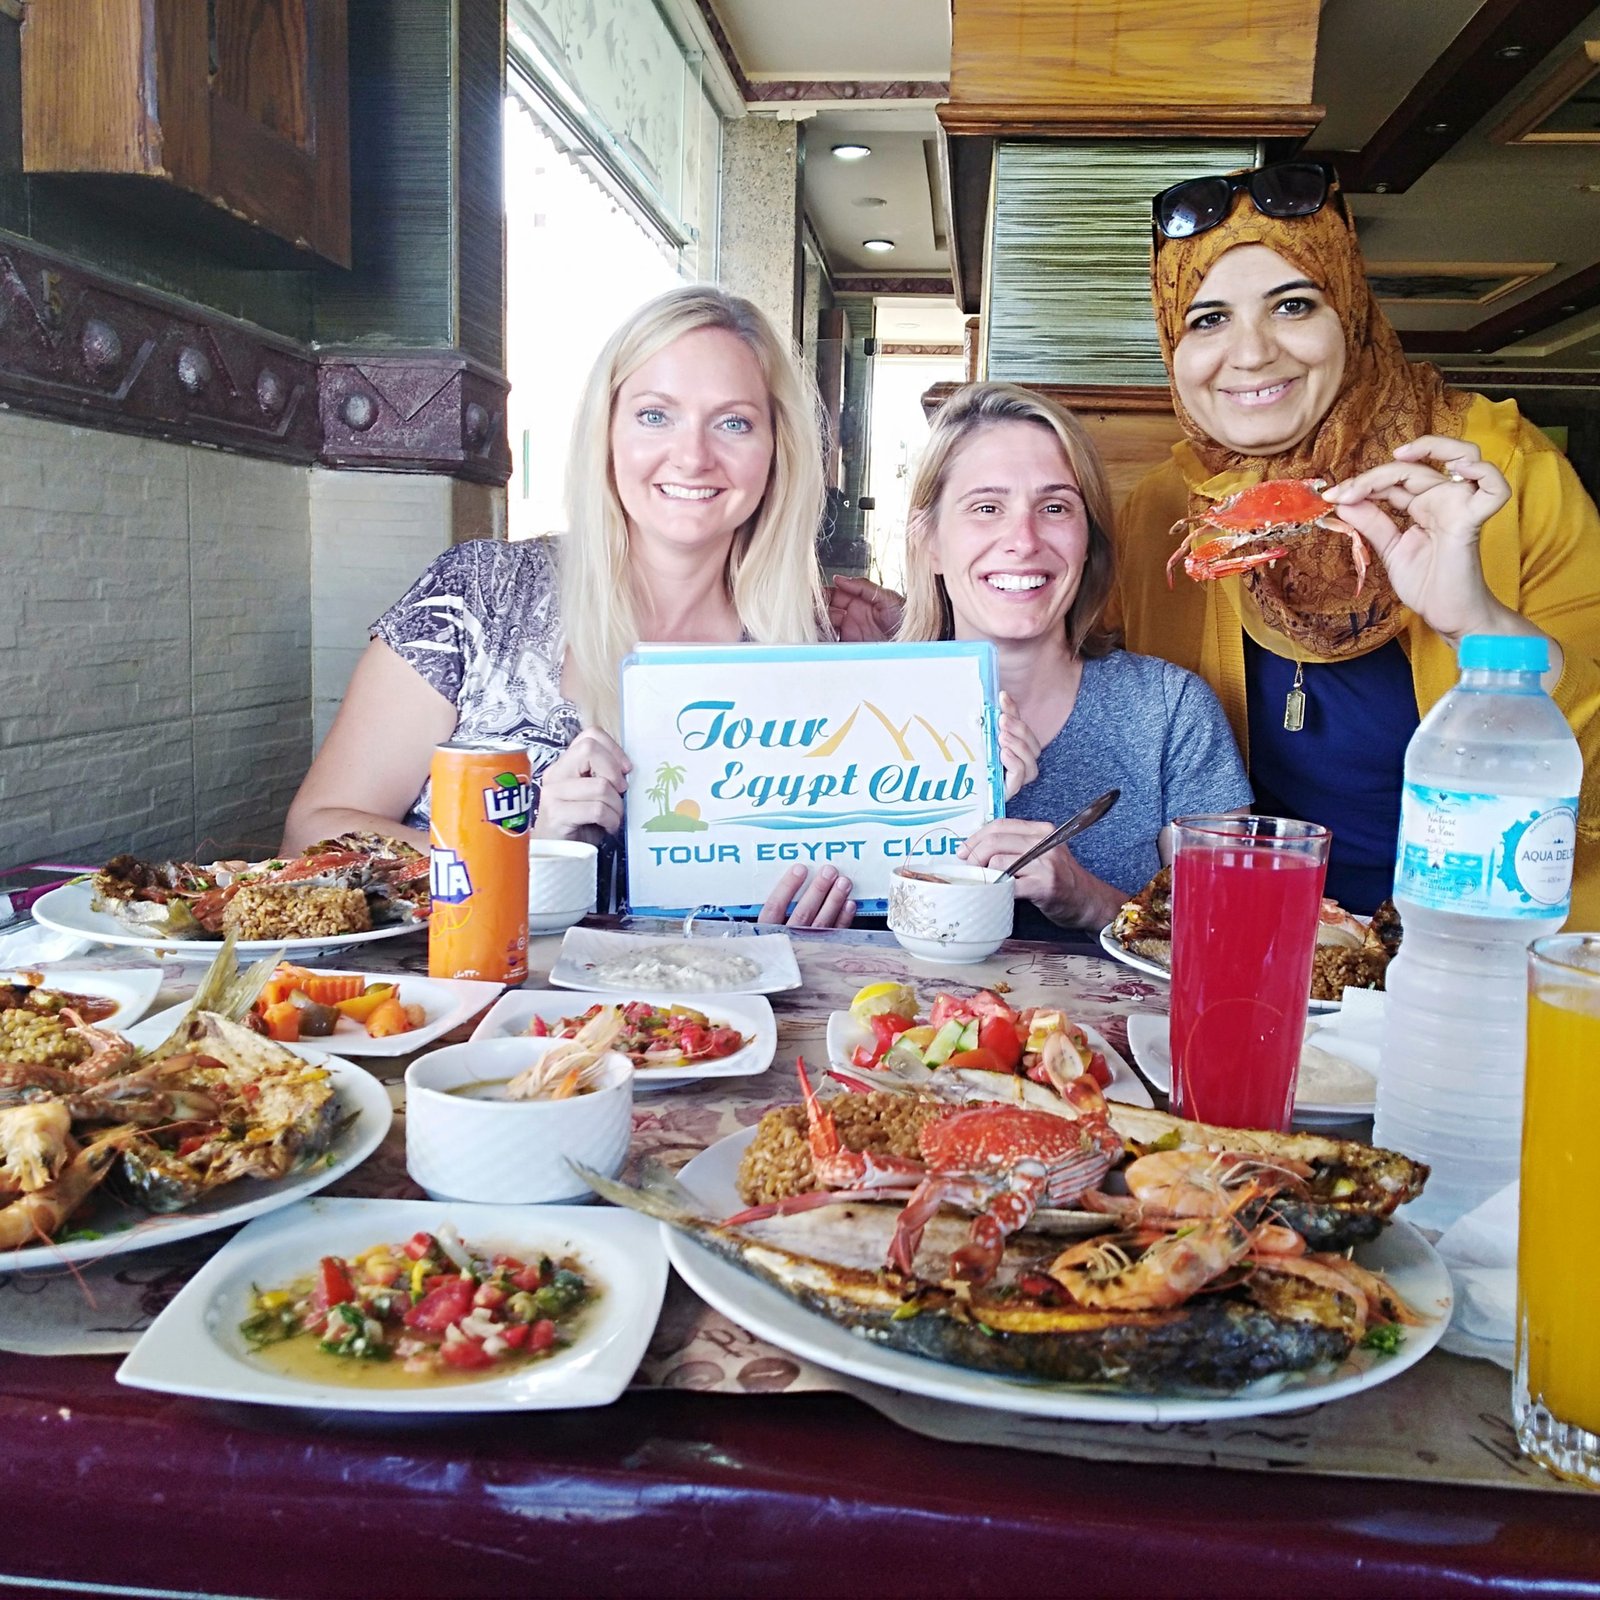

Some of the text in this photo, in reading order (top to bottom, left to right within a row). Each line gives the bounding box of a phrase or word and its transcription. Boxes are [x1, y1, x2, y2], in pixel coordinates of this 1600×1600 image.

[676, 700, 829, 752] Tour
[710, 760, 977, 807] Egypt Club
[648, 843, 741, 867] TOUR
[757, 840, 867, 866] EGYPT
[1521, 850, 1554, 863] AQUA
